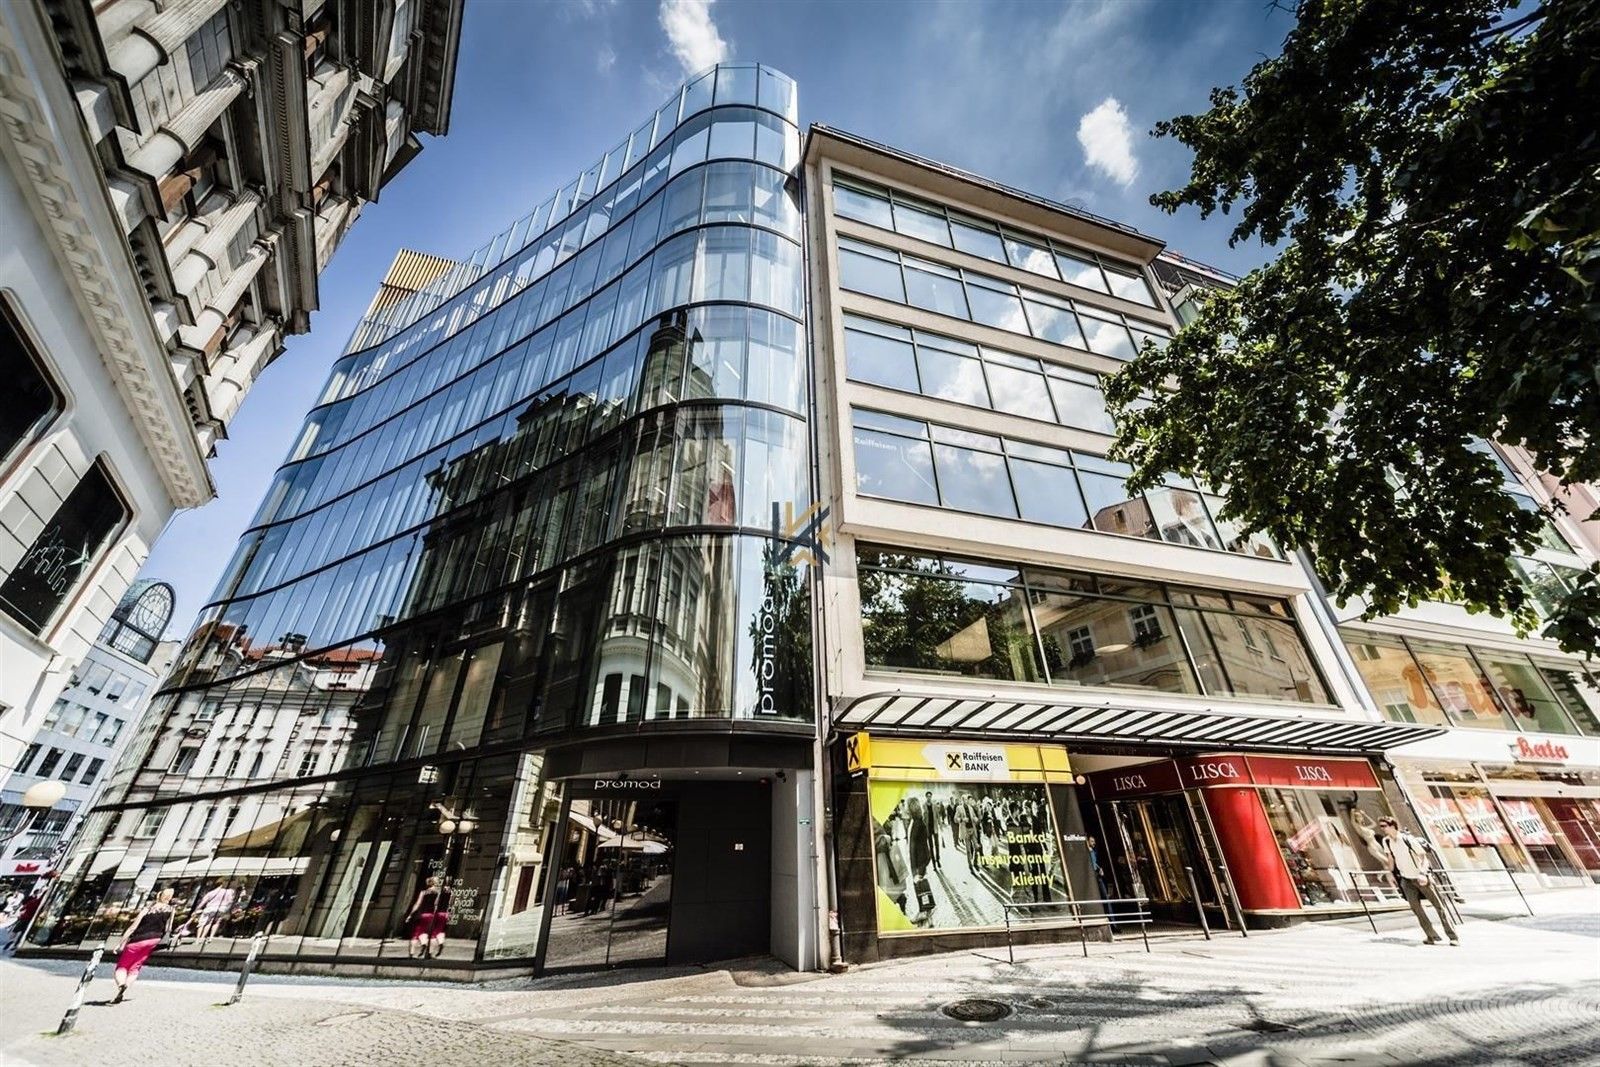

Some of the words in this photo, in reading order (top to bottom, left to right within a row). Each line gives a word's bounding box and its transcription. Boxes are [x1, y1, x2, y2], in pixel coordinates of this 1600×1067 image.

[962, 752, 1004, 762] Raiffeisen
[964, 762, 990, 772] BANK
[1192, 762, 1240, 780] LISCA
[1295, 765, 1333, 782] LISCA
[594, 779, 661, 790] promod
[1113, 774, 1148, 791] LISCA
[1011, 871, 1054, 887] klienty
